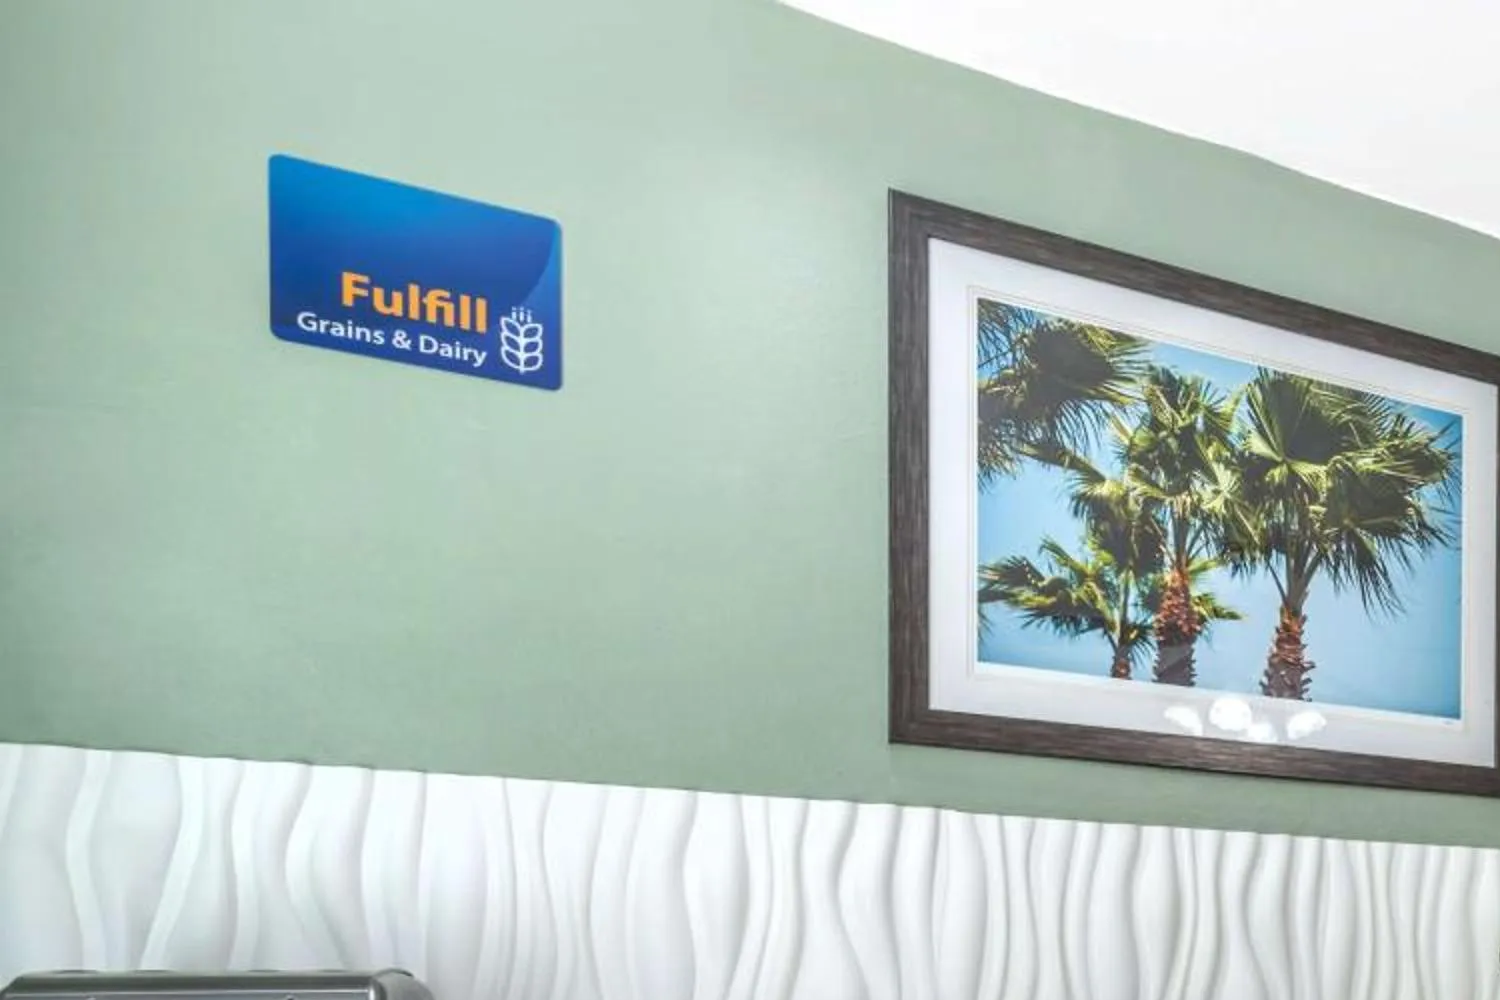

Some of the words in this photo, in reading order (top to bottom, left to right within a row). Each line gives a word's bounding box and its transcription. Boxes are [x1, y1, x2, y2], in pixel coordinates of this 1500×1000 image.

[340, 270, 488, 334] Fulfill
[296, 311, 385, 345] Grains
[391, 330, 412, 351] &
[418, 334, 488, 368] Dairy
